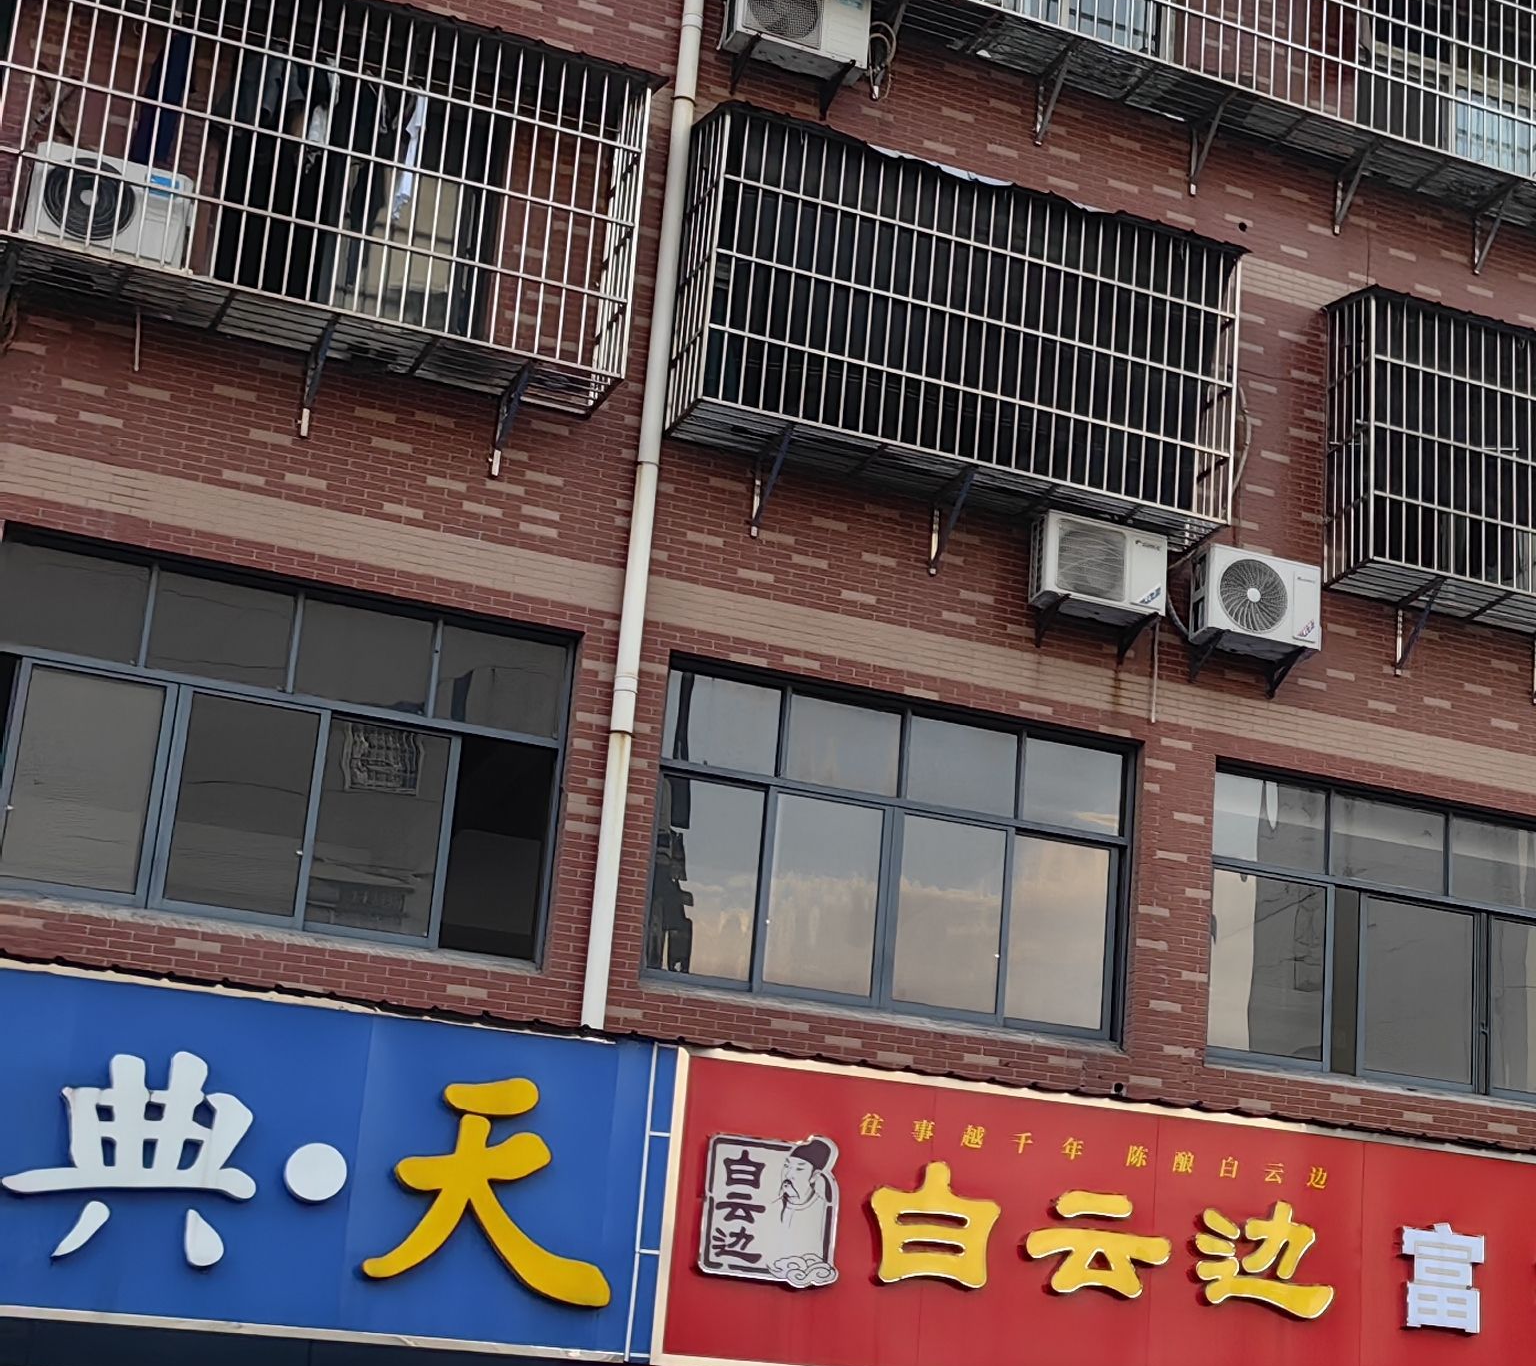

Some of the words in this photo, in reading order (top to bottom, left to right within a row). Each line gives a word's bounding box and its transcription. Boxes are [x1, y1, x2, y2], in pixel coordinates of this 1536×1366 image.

[712, 1149, 767, 1264] 白云边
[858, 1112, 1085, 1161] 往事越千年
[1125, 1144, 1329, 1190] 陈酿白云边
[870, 1160, 1336, 1321] 白云边
